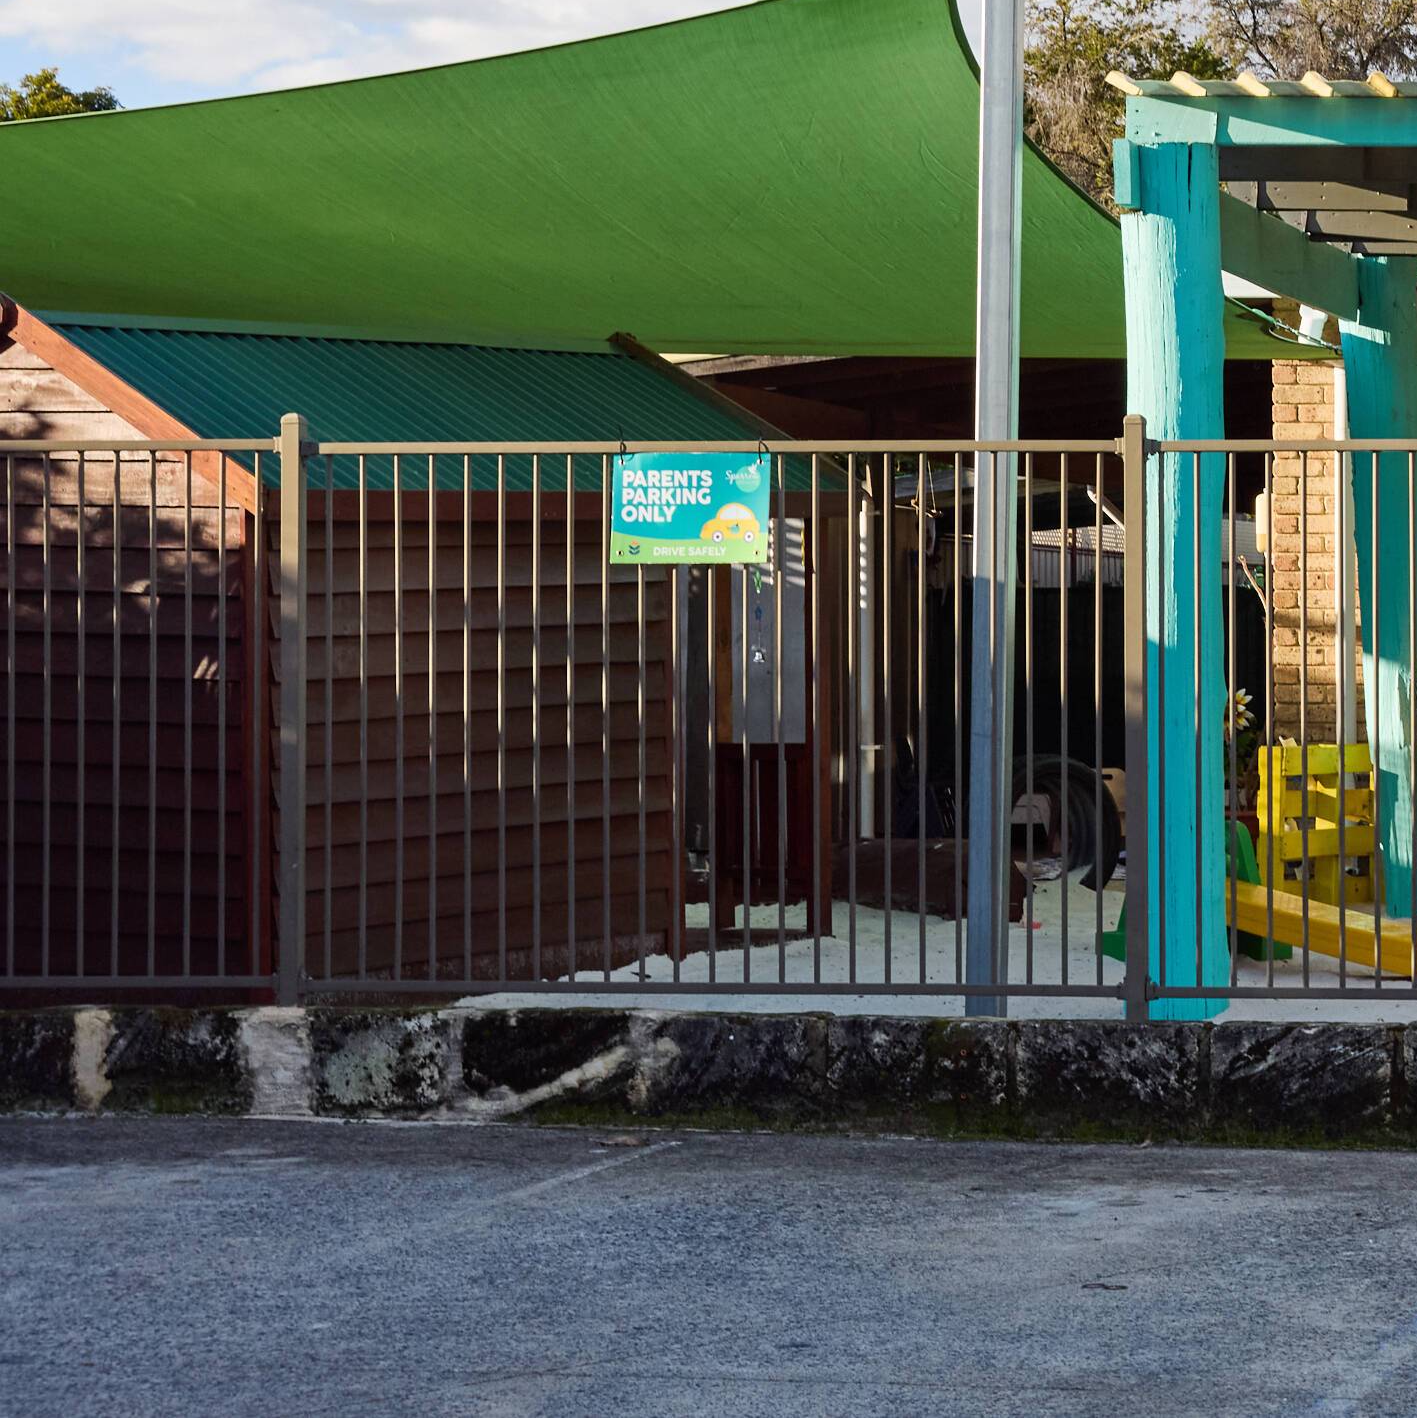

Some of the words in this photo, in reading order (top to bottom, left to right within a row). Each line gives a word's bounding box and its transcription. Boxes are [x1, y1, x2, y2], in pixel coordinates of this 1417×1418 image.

[622, 470, 713, 487] PARENTS
[622, 488, 711, 505] PARKING
[621, 505, 677, 523] ONLY
[653, 546, 686, 556] DRIVE
[688, 546, 726, 556] SAFELY
